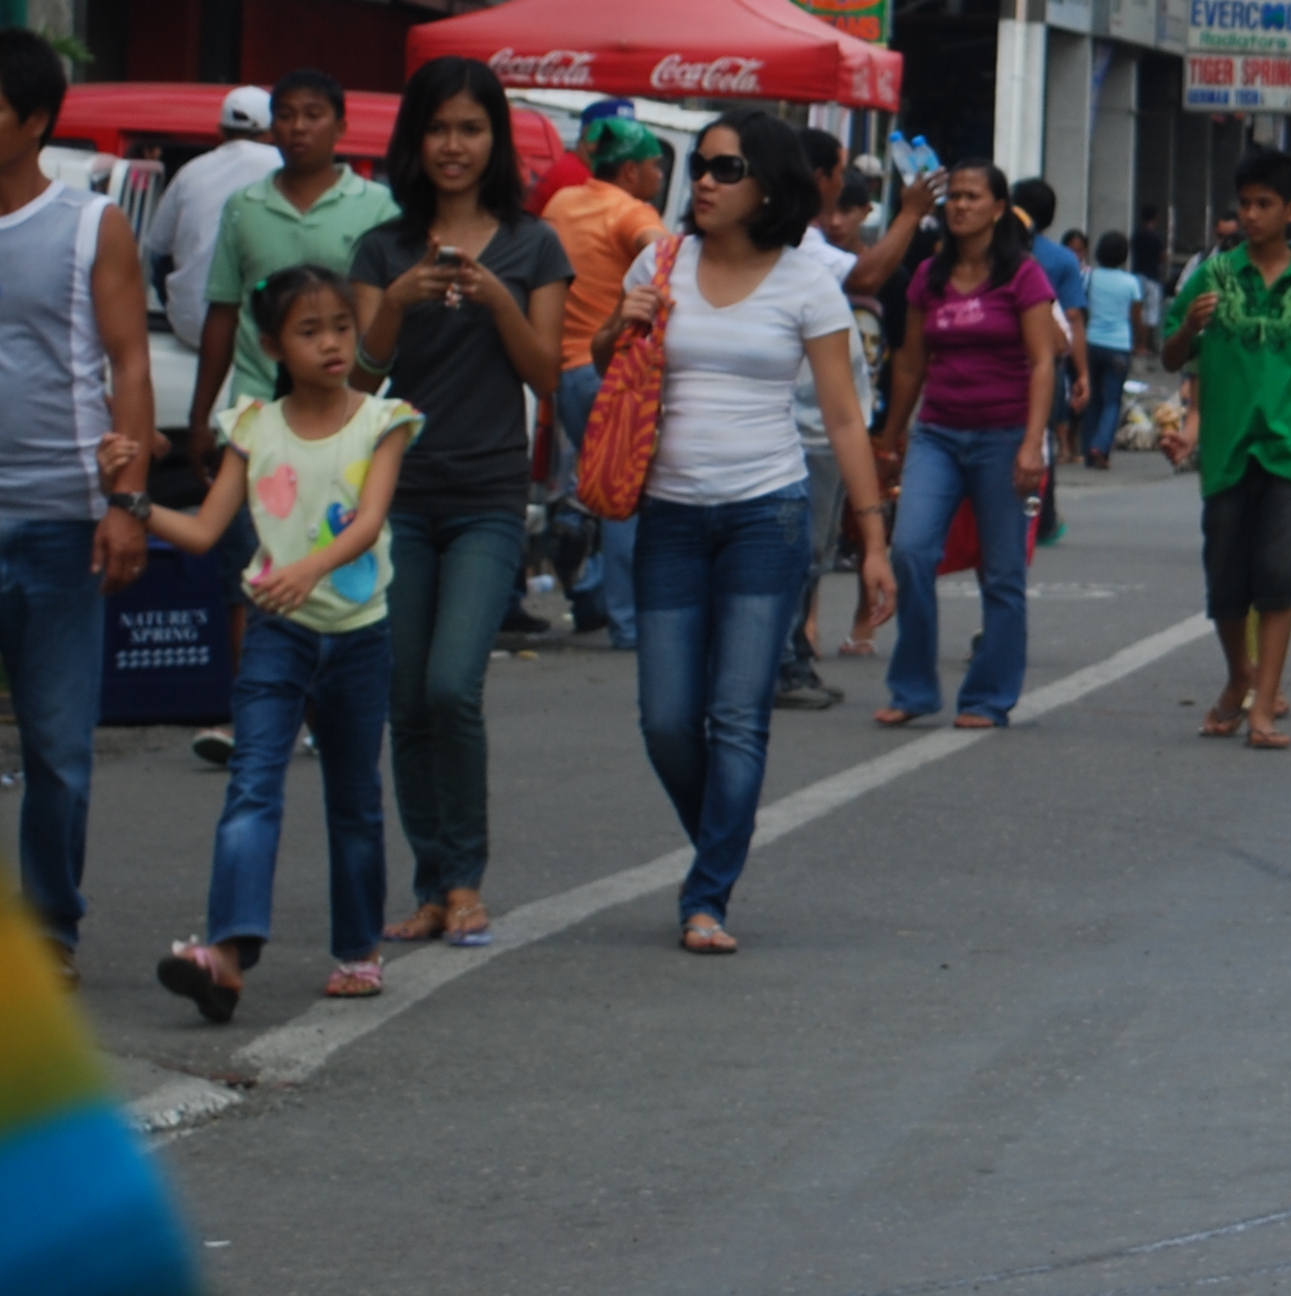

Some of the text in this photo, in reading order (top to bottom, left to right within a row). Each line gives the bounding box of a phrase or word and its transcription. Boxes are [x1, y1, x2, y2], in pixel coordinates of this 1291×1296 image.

[812, 13, 882, 41] EAMS
[1189, 56, 1235, 86] TIGER
[129, 624, 199, 643] SPRING
